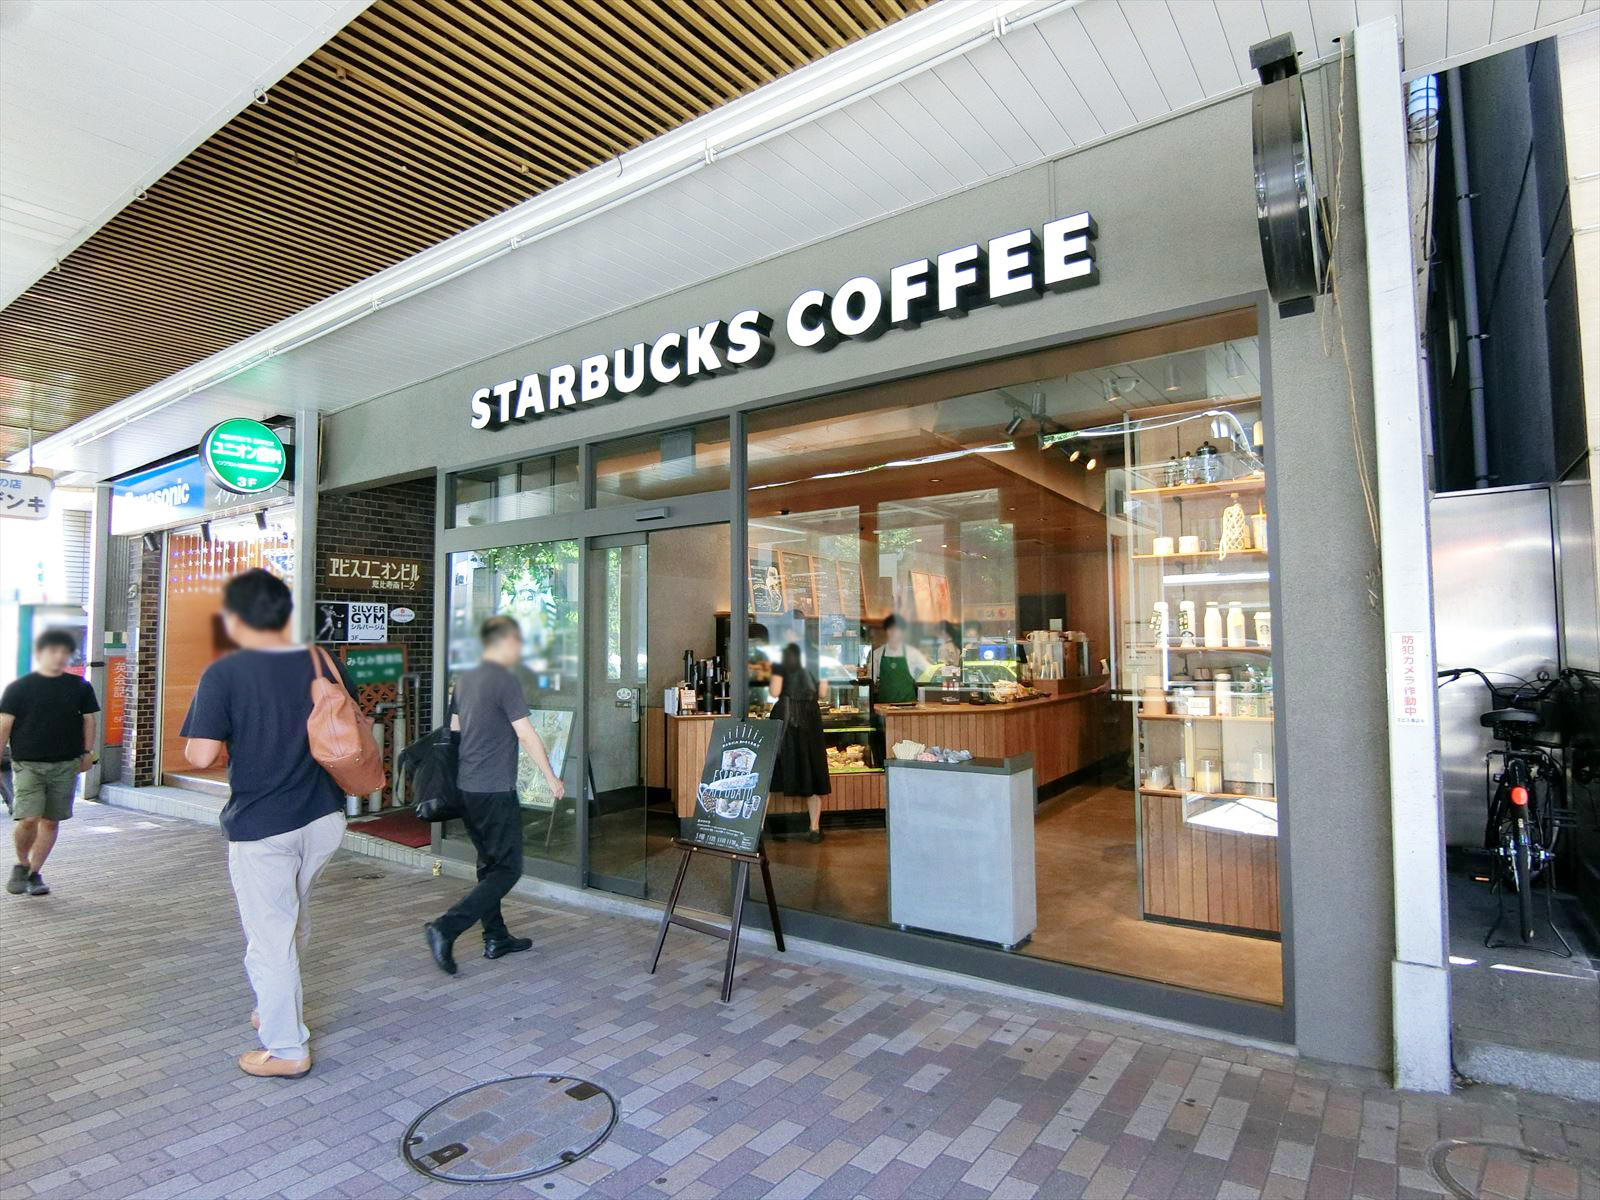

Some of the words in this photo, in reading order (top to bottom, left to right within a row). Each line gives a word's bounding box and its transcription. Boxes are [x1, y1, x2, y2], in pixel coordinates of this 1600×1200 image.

[471, 310, 763, 429] STARBUCKS
[786, 212, 1093, 347] COFFEE
[236, 476, 258, 488] 3F
[351, 605, 386, 614] SILVER
[351, 613, 385, 624] GYM
[1401, 635, 1417, 717] 防犯カメラ作動中
